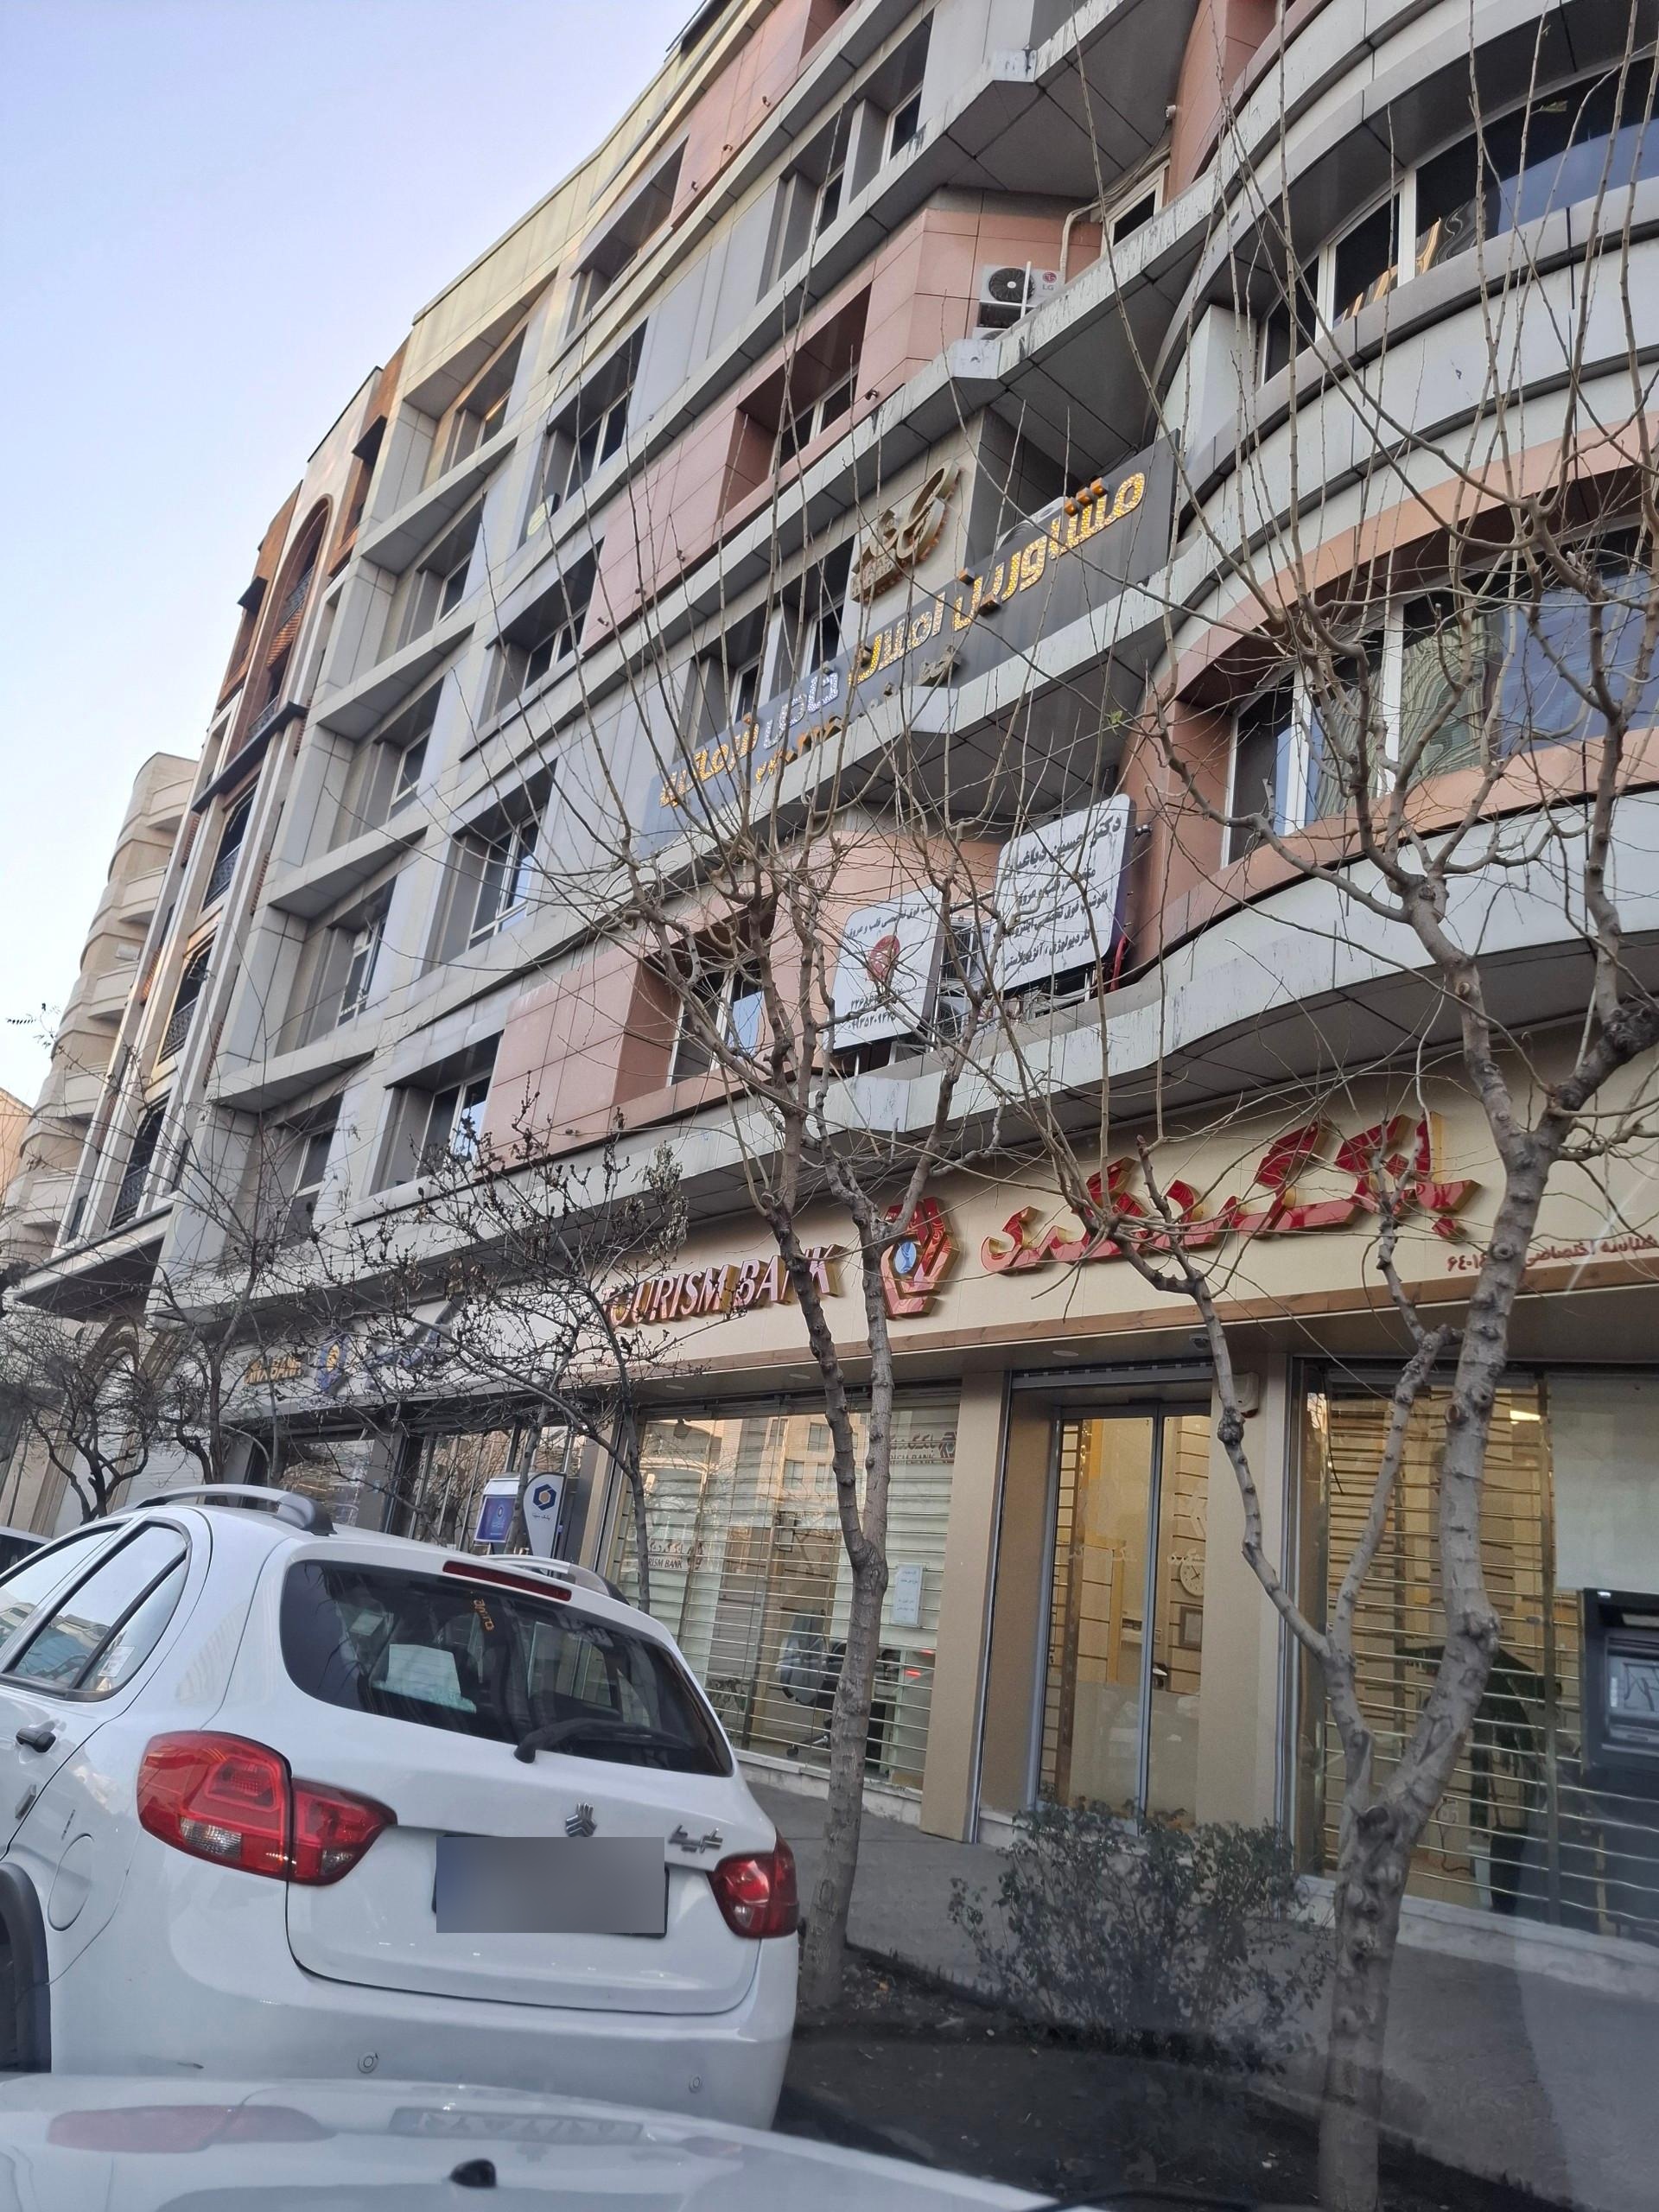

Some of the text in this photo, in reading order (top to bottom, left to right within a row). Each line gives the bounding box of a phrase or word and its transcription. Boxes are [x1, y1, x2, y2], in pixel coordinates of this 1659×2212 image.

[953, 472, 1146, 632] مشاورین
[1049, 833, 1084, 862] حسین
[1090, 815, 1122, 849] دکتر
[869, 917, 881, 931] قلب
[981, 1111, 1481, 1276] بانک گردشگری
[1525, 1240, 1596, 1268] اختصاصی
[601, 1263, 736, 1326] TOURISM
[664, 1559, 683, 1569] BANK
